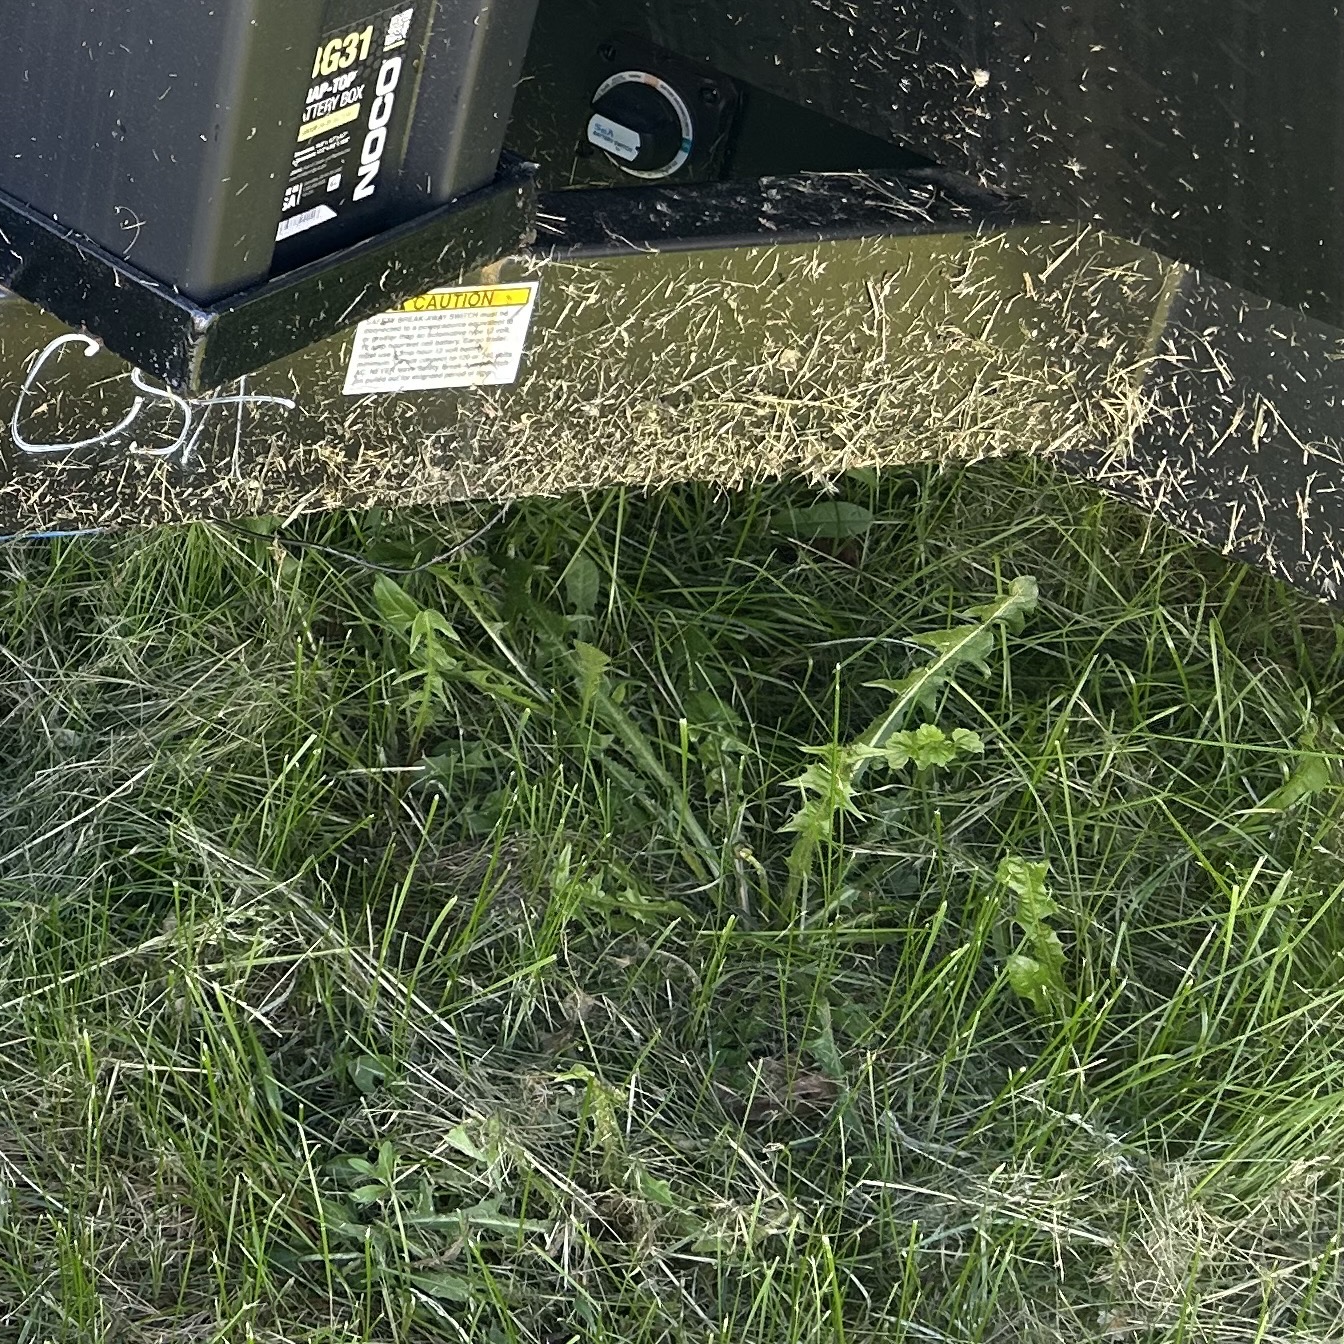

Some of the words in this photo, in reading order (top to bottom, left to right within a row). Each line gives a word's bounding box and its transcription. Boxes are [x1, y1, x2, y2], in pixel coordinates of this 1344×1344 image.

[302, 94, 340, 123] TTERY
[340, 84, 365, 107] BOX
[352, 56, 403, 202] NOCO
[413, 290, 495, 311] CAUTION
